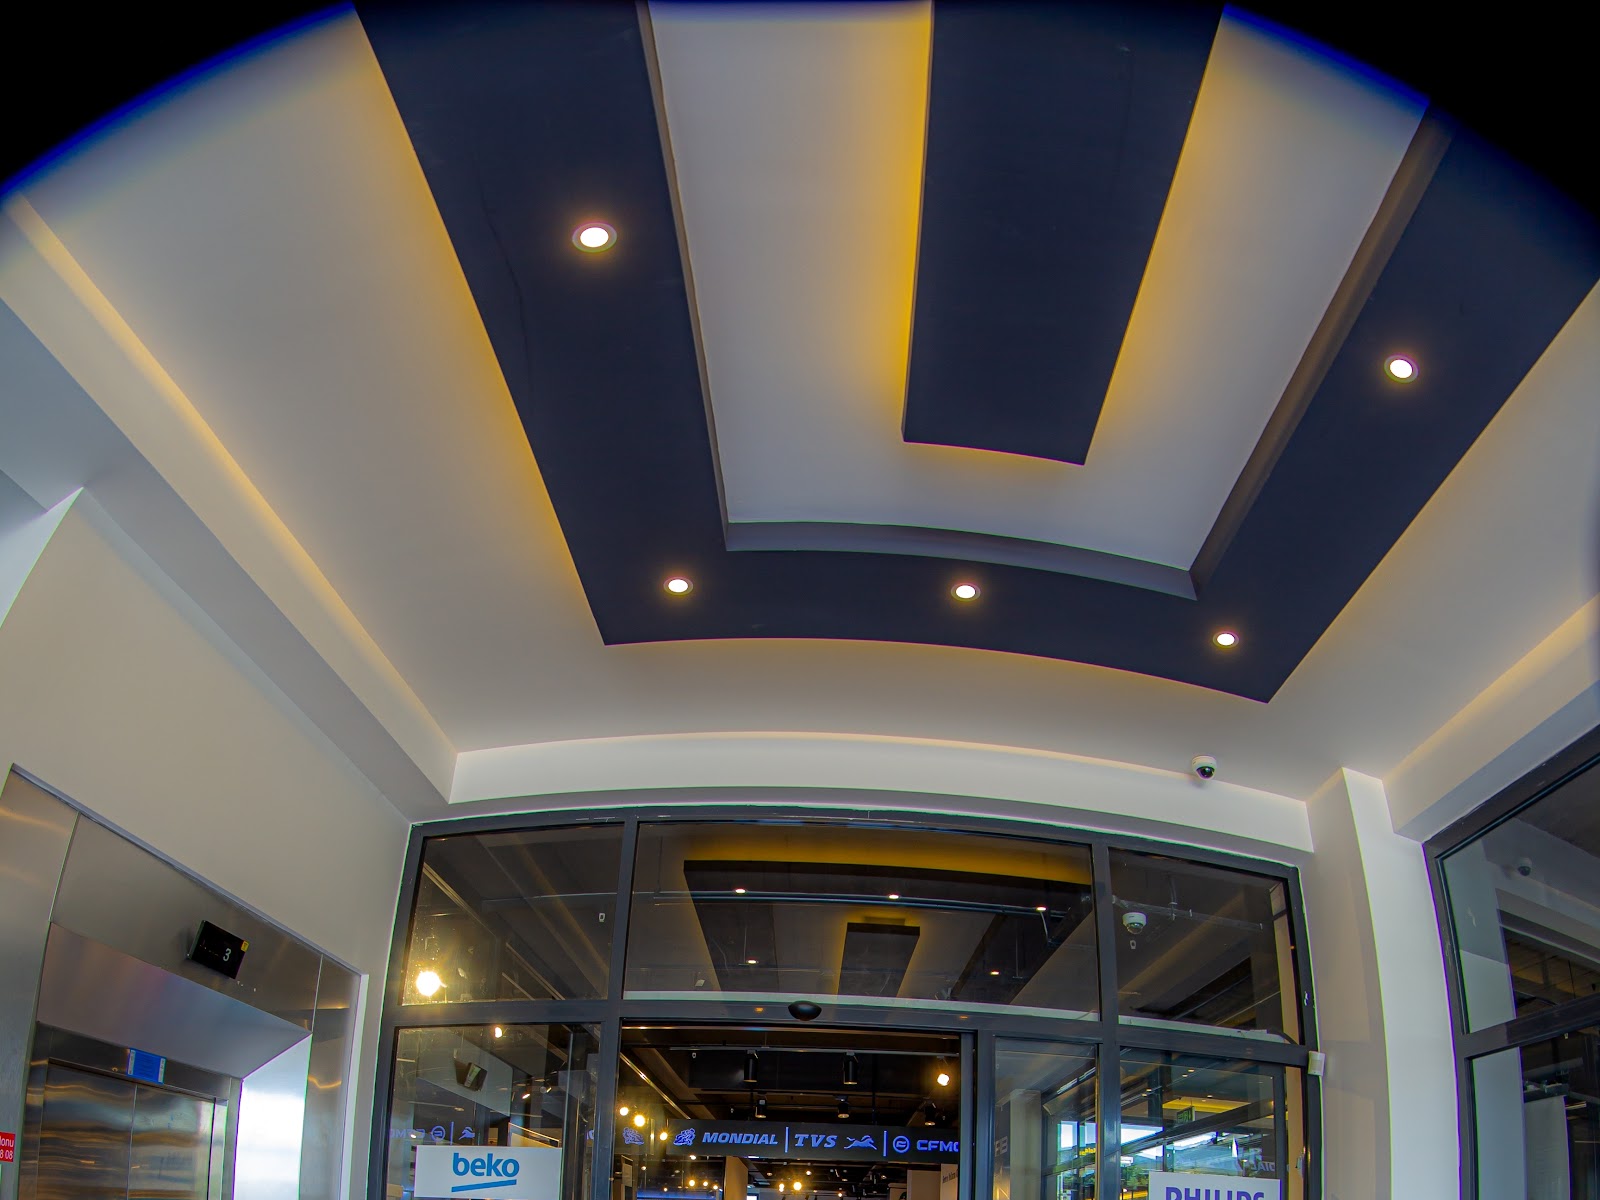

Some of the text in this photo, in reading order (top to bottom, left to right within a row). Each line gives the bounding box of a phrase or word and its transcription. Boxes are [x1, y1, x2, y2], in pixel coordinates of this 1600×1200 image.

[223, 948, 232, 962] 3
[702, 1132, 779, 1145] MONDIAL
[794, 1133, 838, 1148] TVS
[452, 1152, 520, 1178] beko
